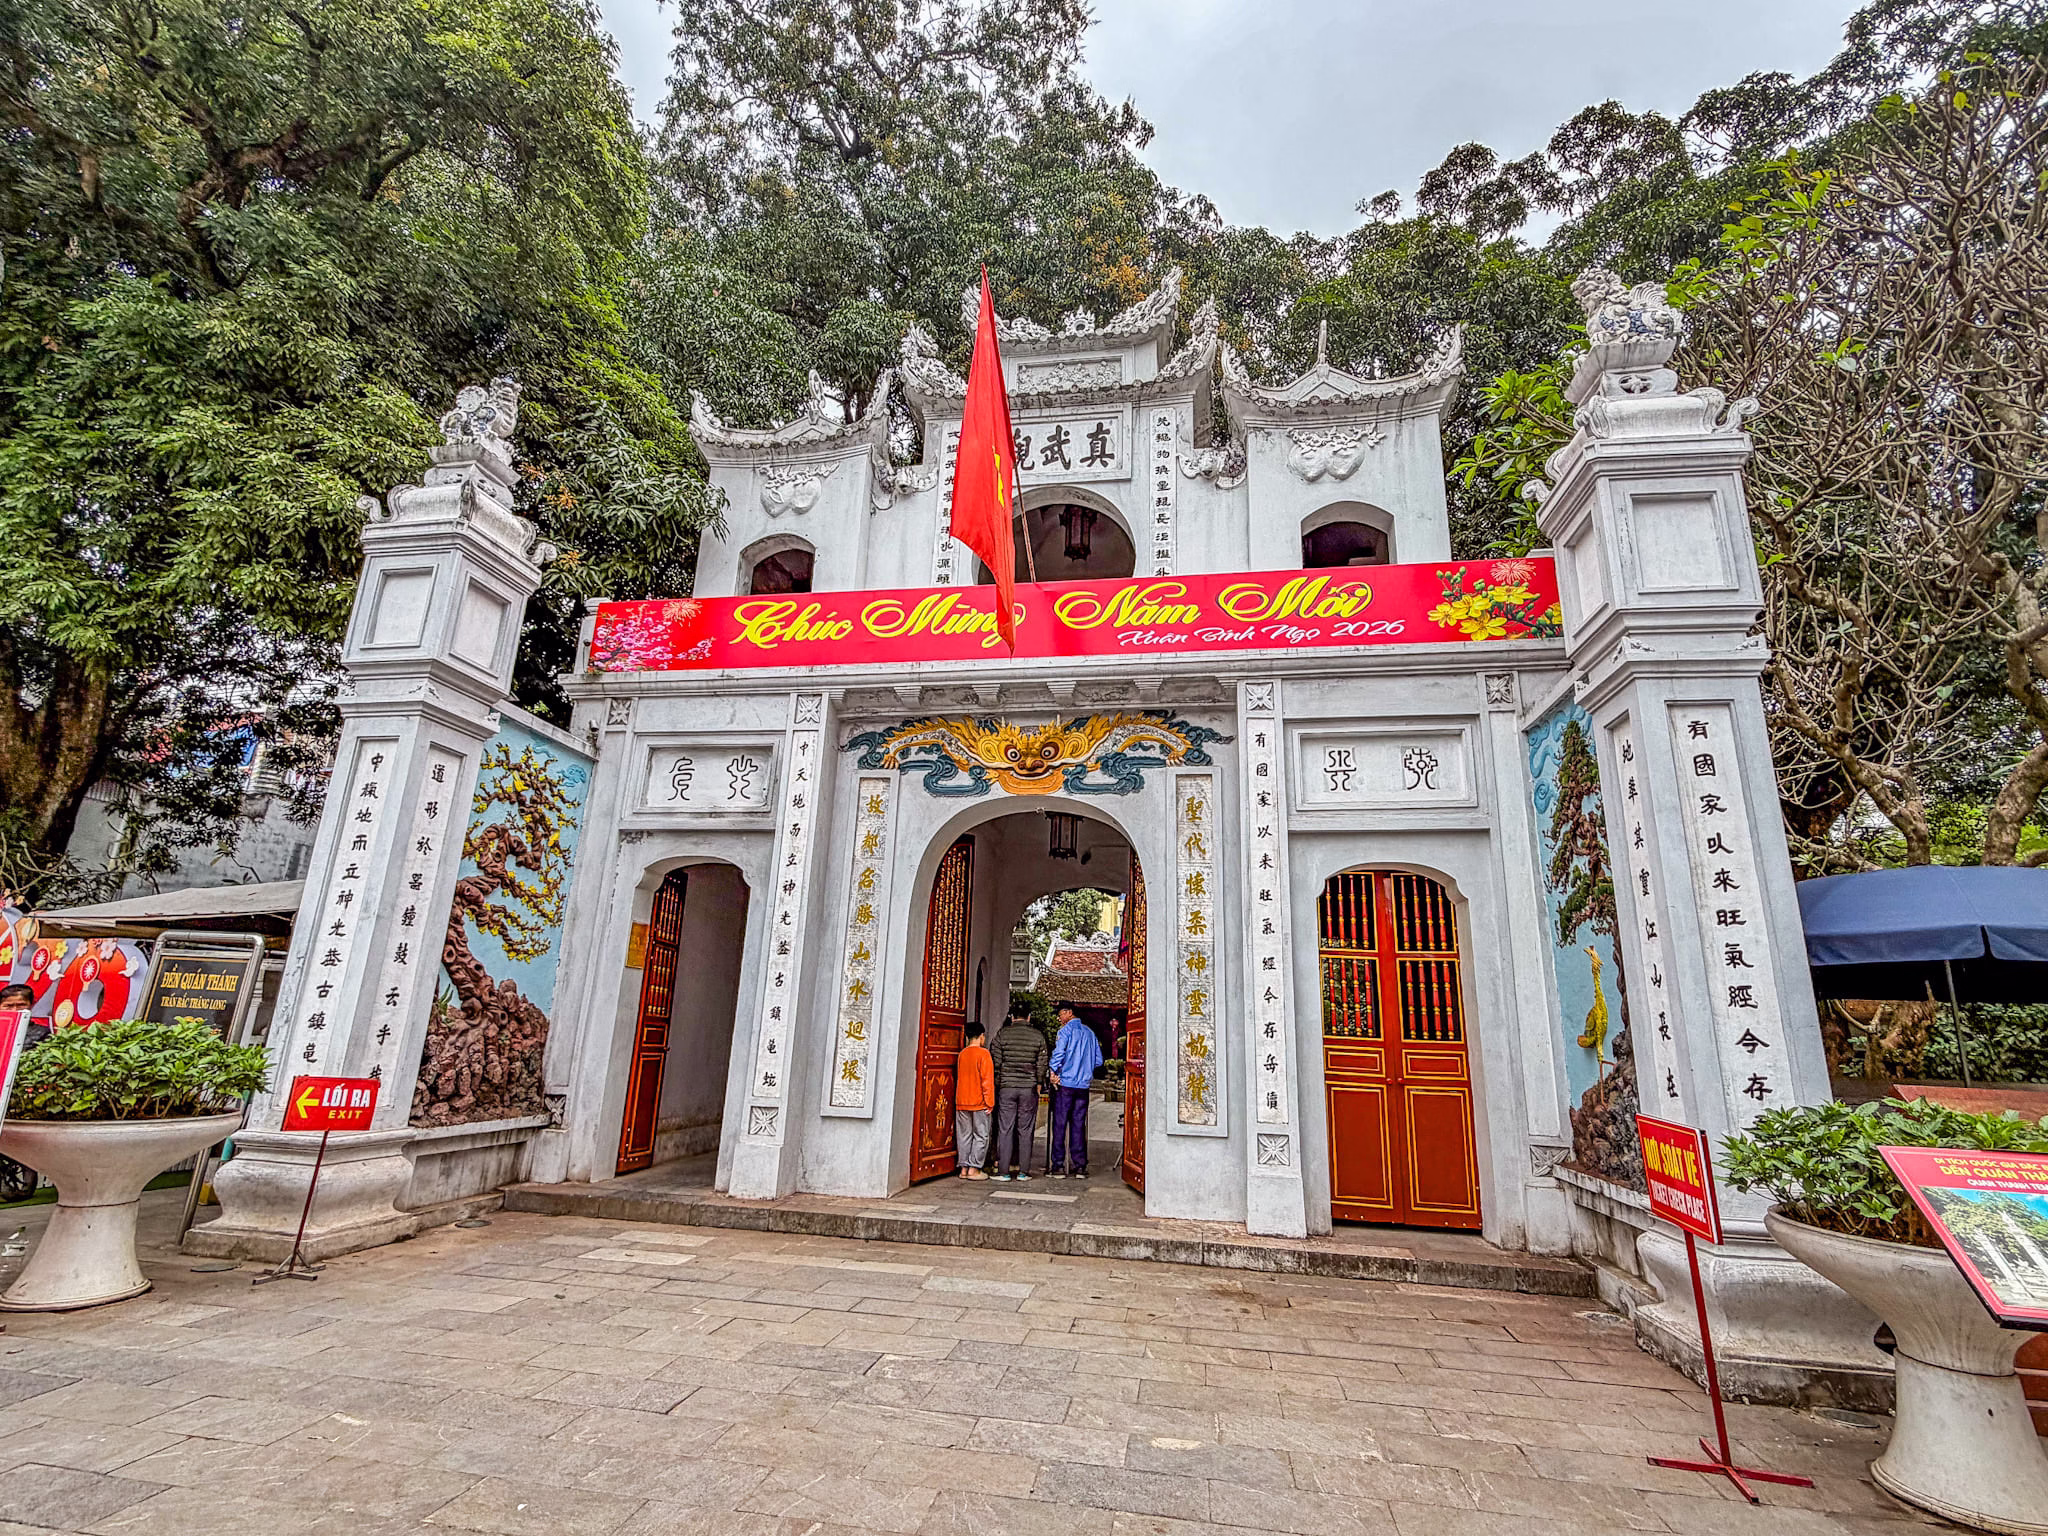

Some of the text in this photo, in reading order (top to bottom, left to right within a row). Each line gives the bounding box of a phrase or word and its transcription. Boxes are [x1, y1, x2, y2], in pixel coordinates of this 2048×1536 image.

[729, 575, 1375, 649] Chúc Mừng Năm Mới
[1118, 619, 1406, 647] Xuân Bính Ngọ 2026
[160, 963, 239, 992] ĐỀN QUÁN THÁNH
[209, 999, 227, 1010] LONG
[322, 1082, 371, 1107] LỐI RA
[328, 1109, 363, 1119] EXIT
[1643, 1135, 1700, 1187] NƠI SOÁT VÉ
[1686, 1193, 1707, 1224] PLACE
